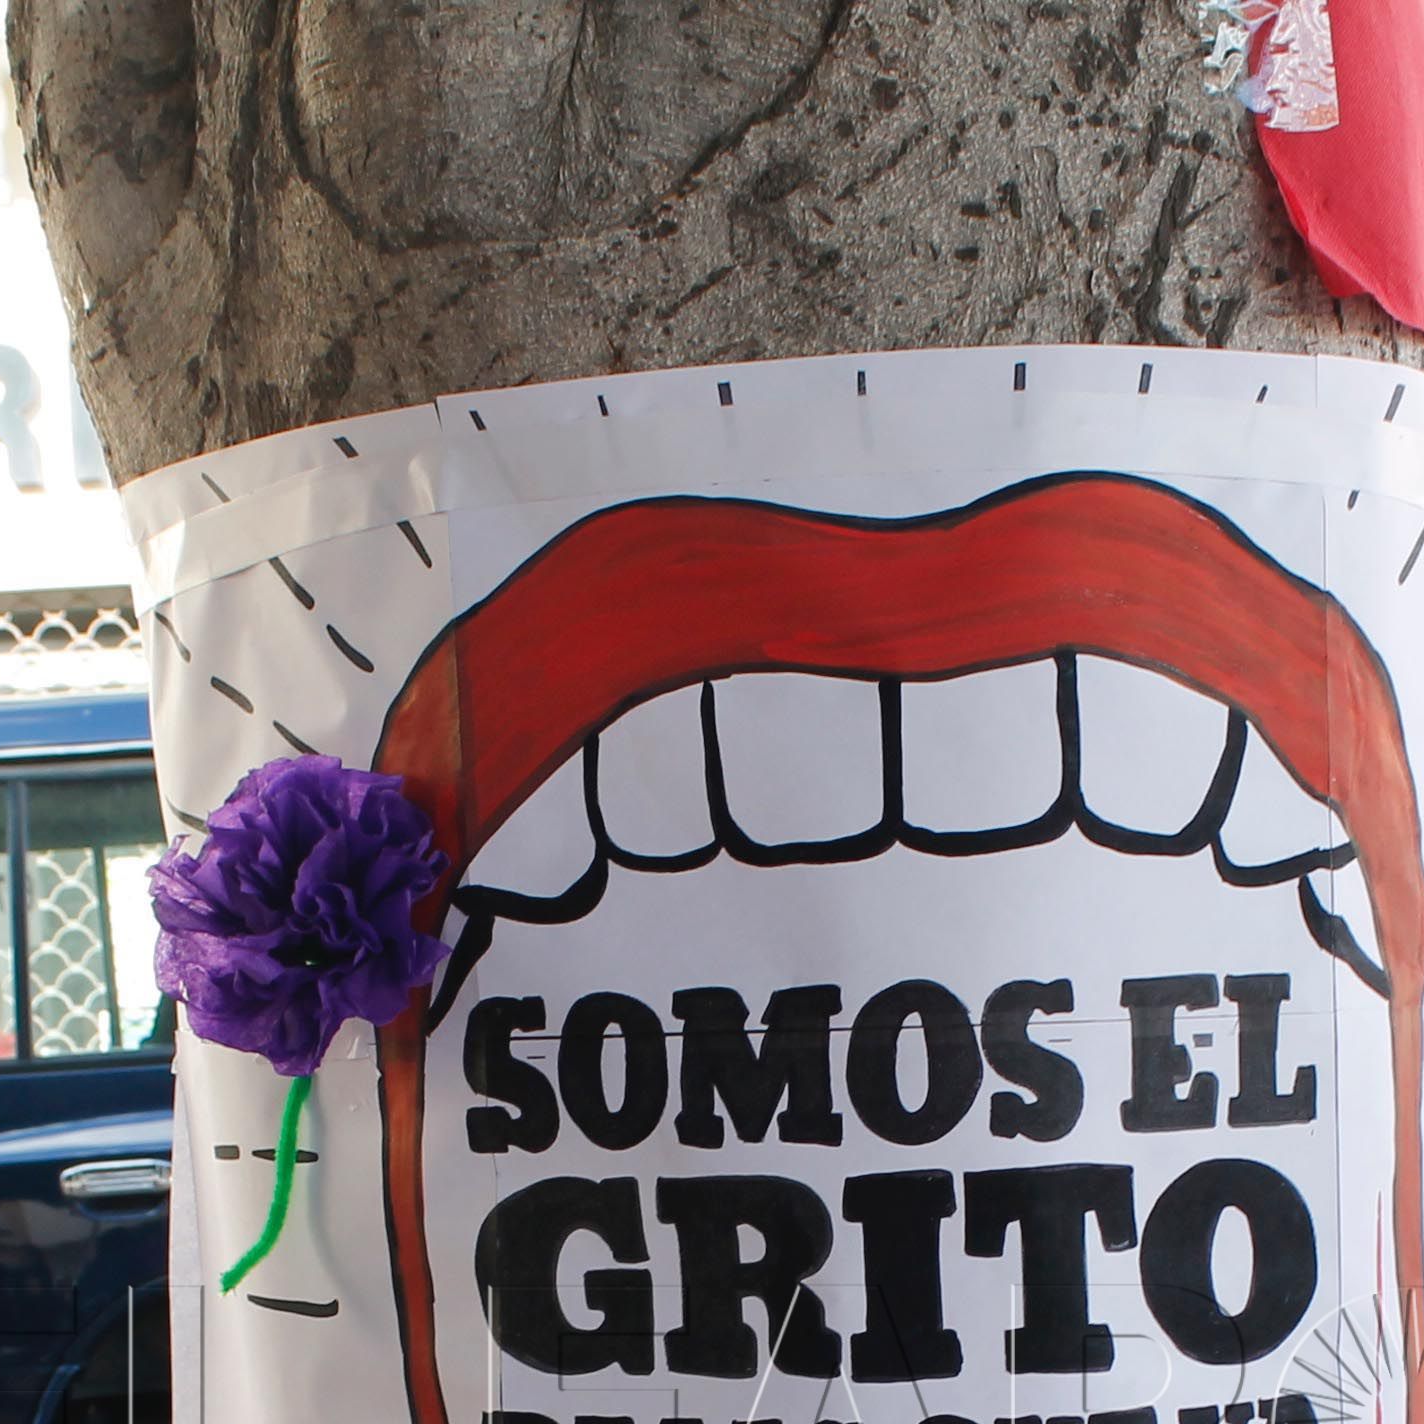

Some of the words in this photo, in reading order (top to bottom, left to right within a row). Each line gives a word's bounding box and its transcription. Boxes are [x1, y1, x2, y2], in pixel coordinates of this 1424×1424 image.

[462, 979, 1086, 1154] SOMOS
[1119, 973, 1318, 1134] EL
[473, 1157, 1319, 1384] GRITO
